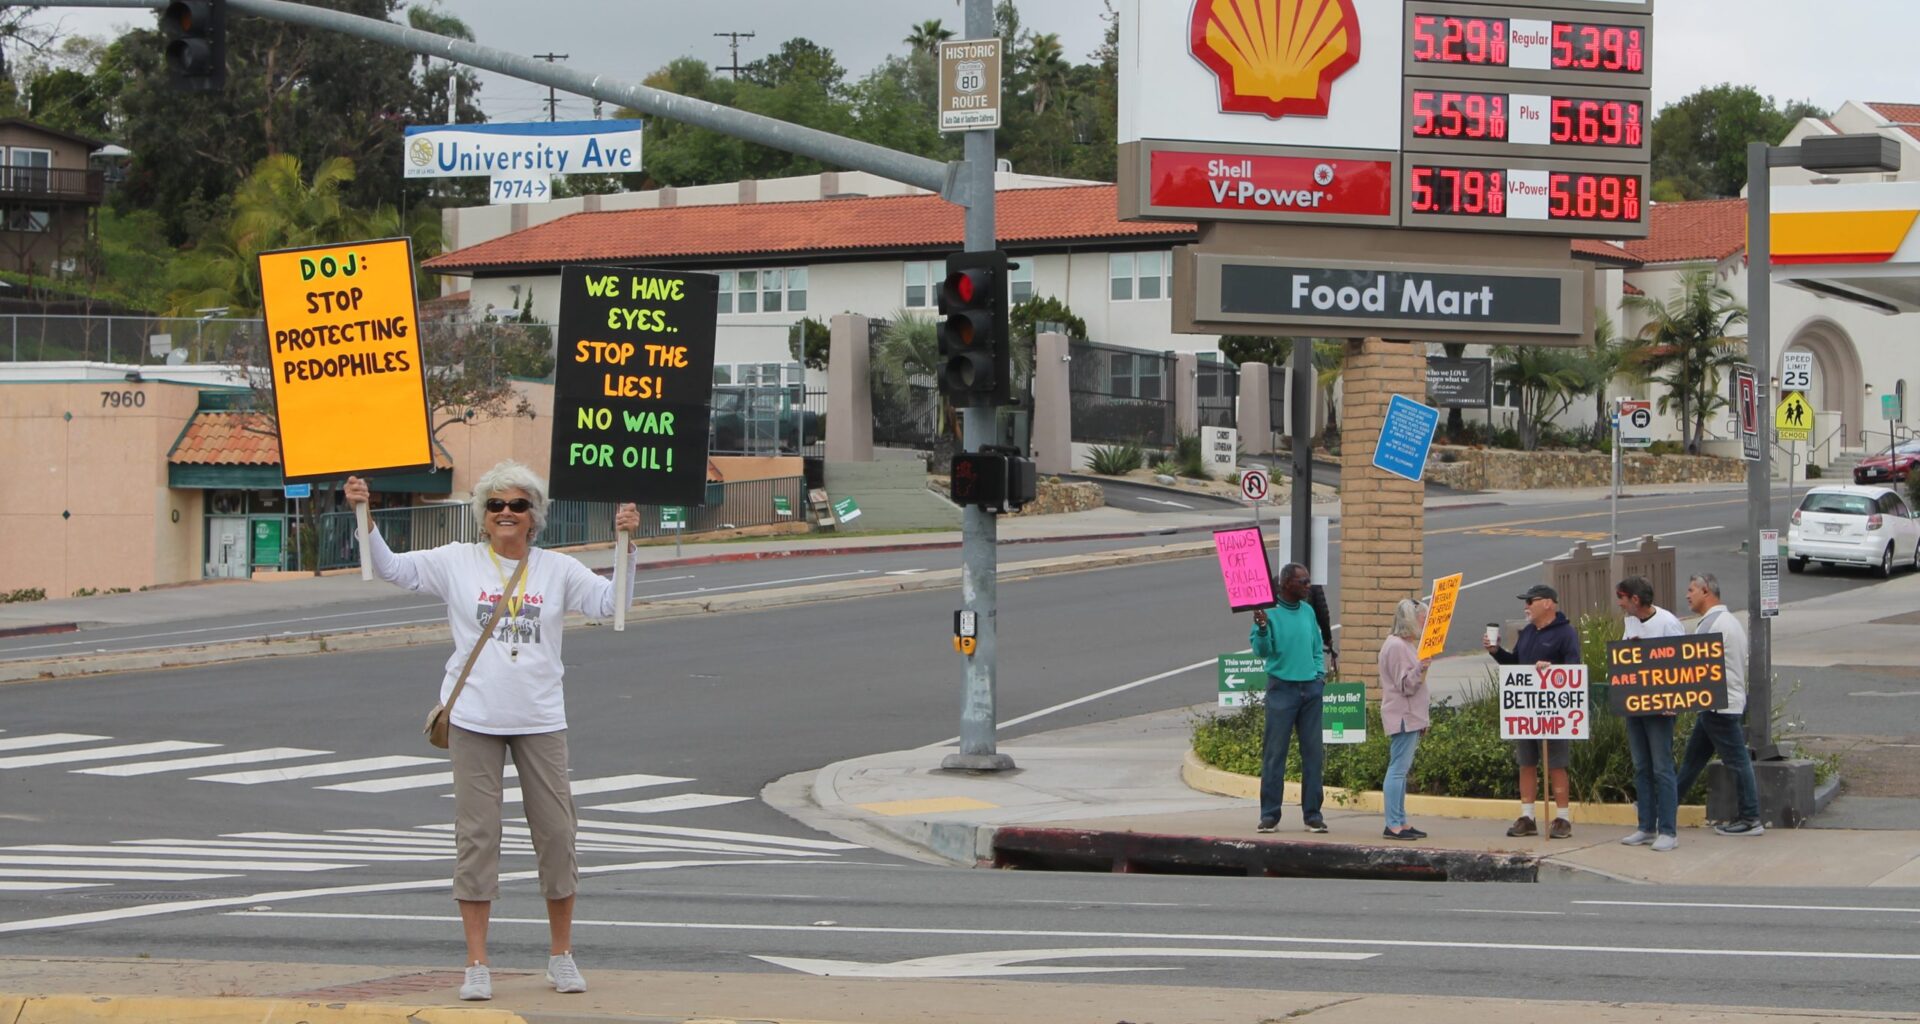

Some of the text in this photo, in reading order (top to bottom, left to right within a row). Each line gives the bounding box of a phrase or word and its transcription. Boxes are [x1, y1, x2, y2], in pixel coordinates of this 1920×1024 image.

[1415, 17, 1487, 62] 5.29
[1512, 31, 1548, 48] Regular
[1552, 25, 1623, 69] 5.39
[946, 45, 995, 59] HISTORIC
[962, 76, 979, 89] 80
[952, 95, 988, 109] ROUTE
[1413, 92, 1486, 136] 5.59
[1520, 107, 1539, 121] Plus
[1552, 101, 1622, 144] 5.69
[438, 138, 631, 172] University Ave
[1208, 160, 1252, 178] Shell
[493, 180, 533, 198] 7974
[1209, 180, 1324, 208] V-Power
[1412, 168, 1484, 213] 5.79
[1509, 182, 1548, 196] V-Power
[1550, 175, 1620, 219] 5.89
[300, 253, 367, 281] DOJ:
[585, 275, 685, 301] WE HAVE
[1292, 274, 1493, 316] Food Mart
[306, 287, 363, 314] STOP
[607, 307, 678, 332] EYES..
[275, 316, 408, 353] PROTECTING
[575, 340, 688, 368] STOP THE
[283, 351, 410, 384] PEDOPHILES
[1784, 372, 1809, 386] 25
[604, 373, 662, 399] LIES!
[100, 391, 145, 408] 7960
[577, 407, 675, 435] NO WAR
[1781, 431, 1806, 439] SCHOOL
[569, 443, 673, 472] FOR OIL!
[1218, 531, 1256, 552] HANDS
[1227, 552, 1249, 568] OFF
[1225, 569, 1265, 585] SOCIAL
[1612, 641, 1722, 665] ICE AND DHS
[1505, 668, 1582, 689] ARE YOU
[1611, 664, 1722, 686] ARE TRUMP'S
[1338, 694, 1345, 702] to
[1346, 692, 1361, 702] file?
[1504, 690, 1584, 709] BETTER OFF
[1626, 690, 1713, 711] GESTAPO
